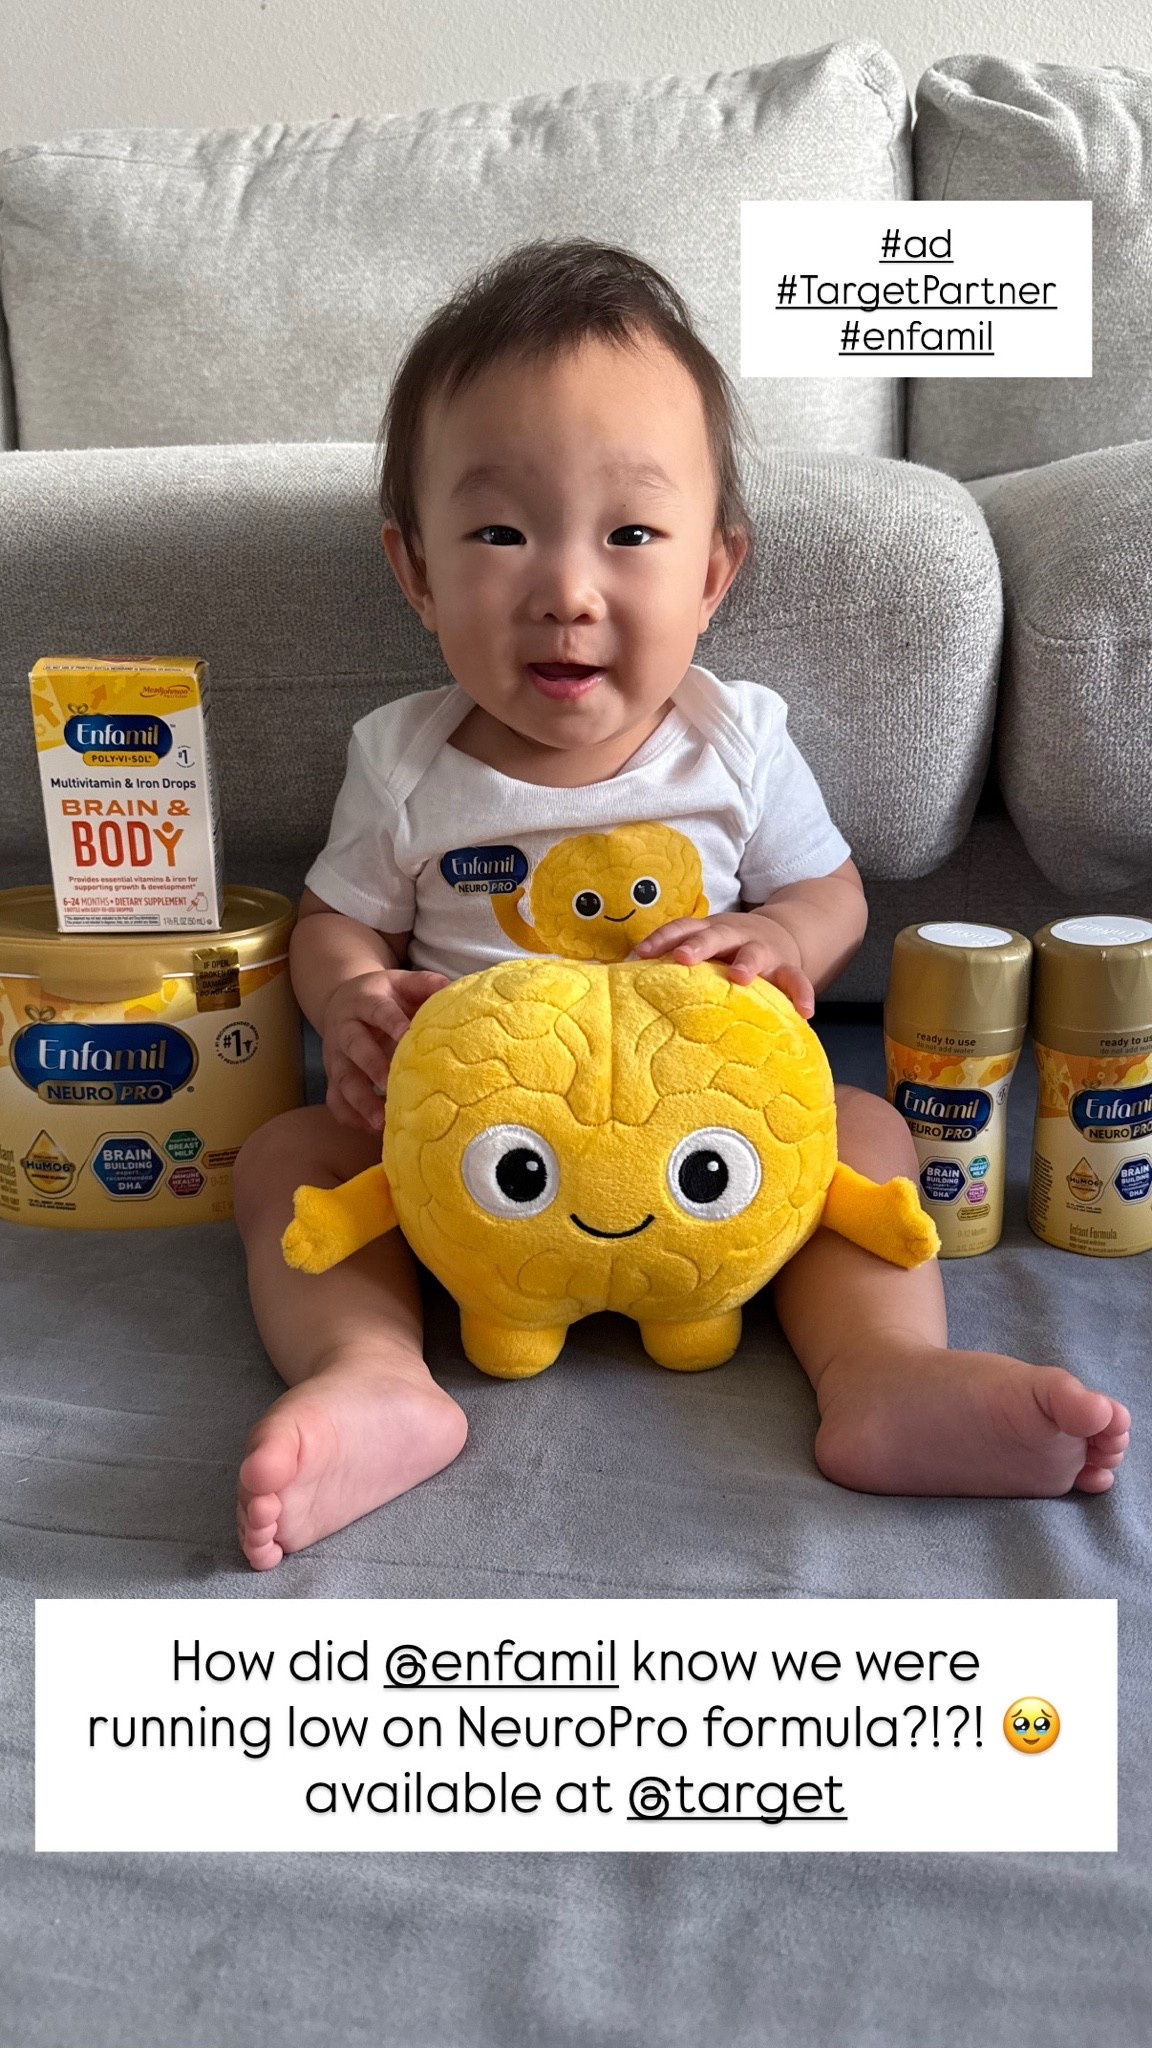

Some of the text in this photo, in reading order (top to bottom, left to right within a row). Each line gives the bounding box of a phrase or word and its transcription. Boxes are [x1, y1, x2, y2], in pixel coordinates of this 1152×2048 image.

[76, 723, 159, 746] Enfamil
[51, 777, 197, 791] Multivitamin & Iron Drops
[61, 799, 191, 817] BRAIN &
[71, 820, 185, 868] BODY
[451, 854, 515, 877] Enfamil
[74, 884, 114, 892] supporting
[114, 884, 140, 892] growth
[458, 881, 513, 893] NEURO PRO
[81, 897, 109, 906] MONTHS
[115, 897, 143, 906] DIETARY
[144, 897, 187, 906] SUPPLEMENT
[222, 1029, 242, 1057] #1
[916, 1032, 977, 1047] ready to use
[1099, 1037, 1129, 1048] ready
[1131, 1036, 1141, 1045] to
[39, 1038, 167, 1071] Enfamil
[47, 1084, 164, 1101] NEURO PRO
[903, 1089, 980, 1120] Enfamil
[944, 1127, 973, 1139] PRO
[1088, 1127, 1130, 1140] NEURO
[168, 1141, 199, 1151] BREAST
[103, 1149, 152, 1162] BRAIN
[174, 1149, 194, 1157] MILK
[104, 1161, 153, 1170] BUILDING
[1120, 1163, 1150, 1178] BRAIN
[926, 1166, 960, 1178] BRAIN
[1120, 1172, 1150, 1184] BUILDING
[118, 1181, 142, 1191] DHA
[926, 1176, 960, 1185] BUILDING
[932, 1190, 950, 1198] DHA
[1129, 1189, 1144, 1198] DHA
[1069, 1222, 1118, 1240] Infant Formula
